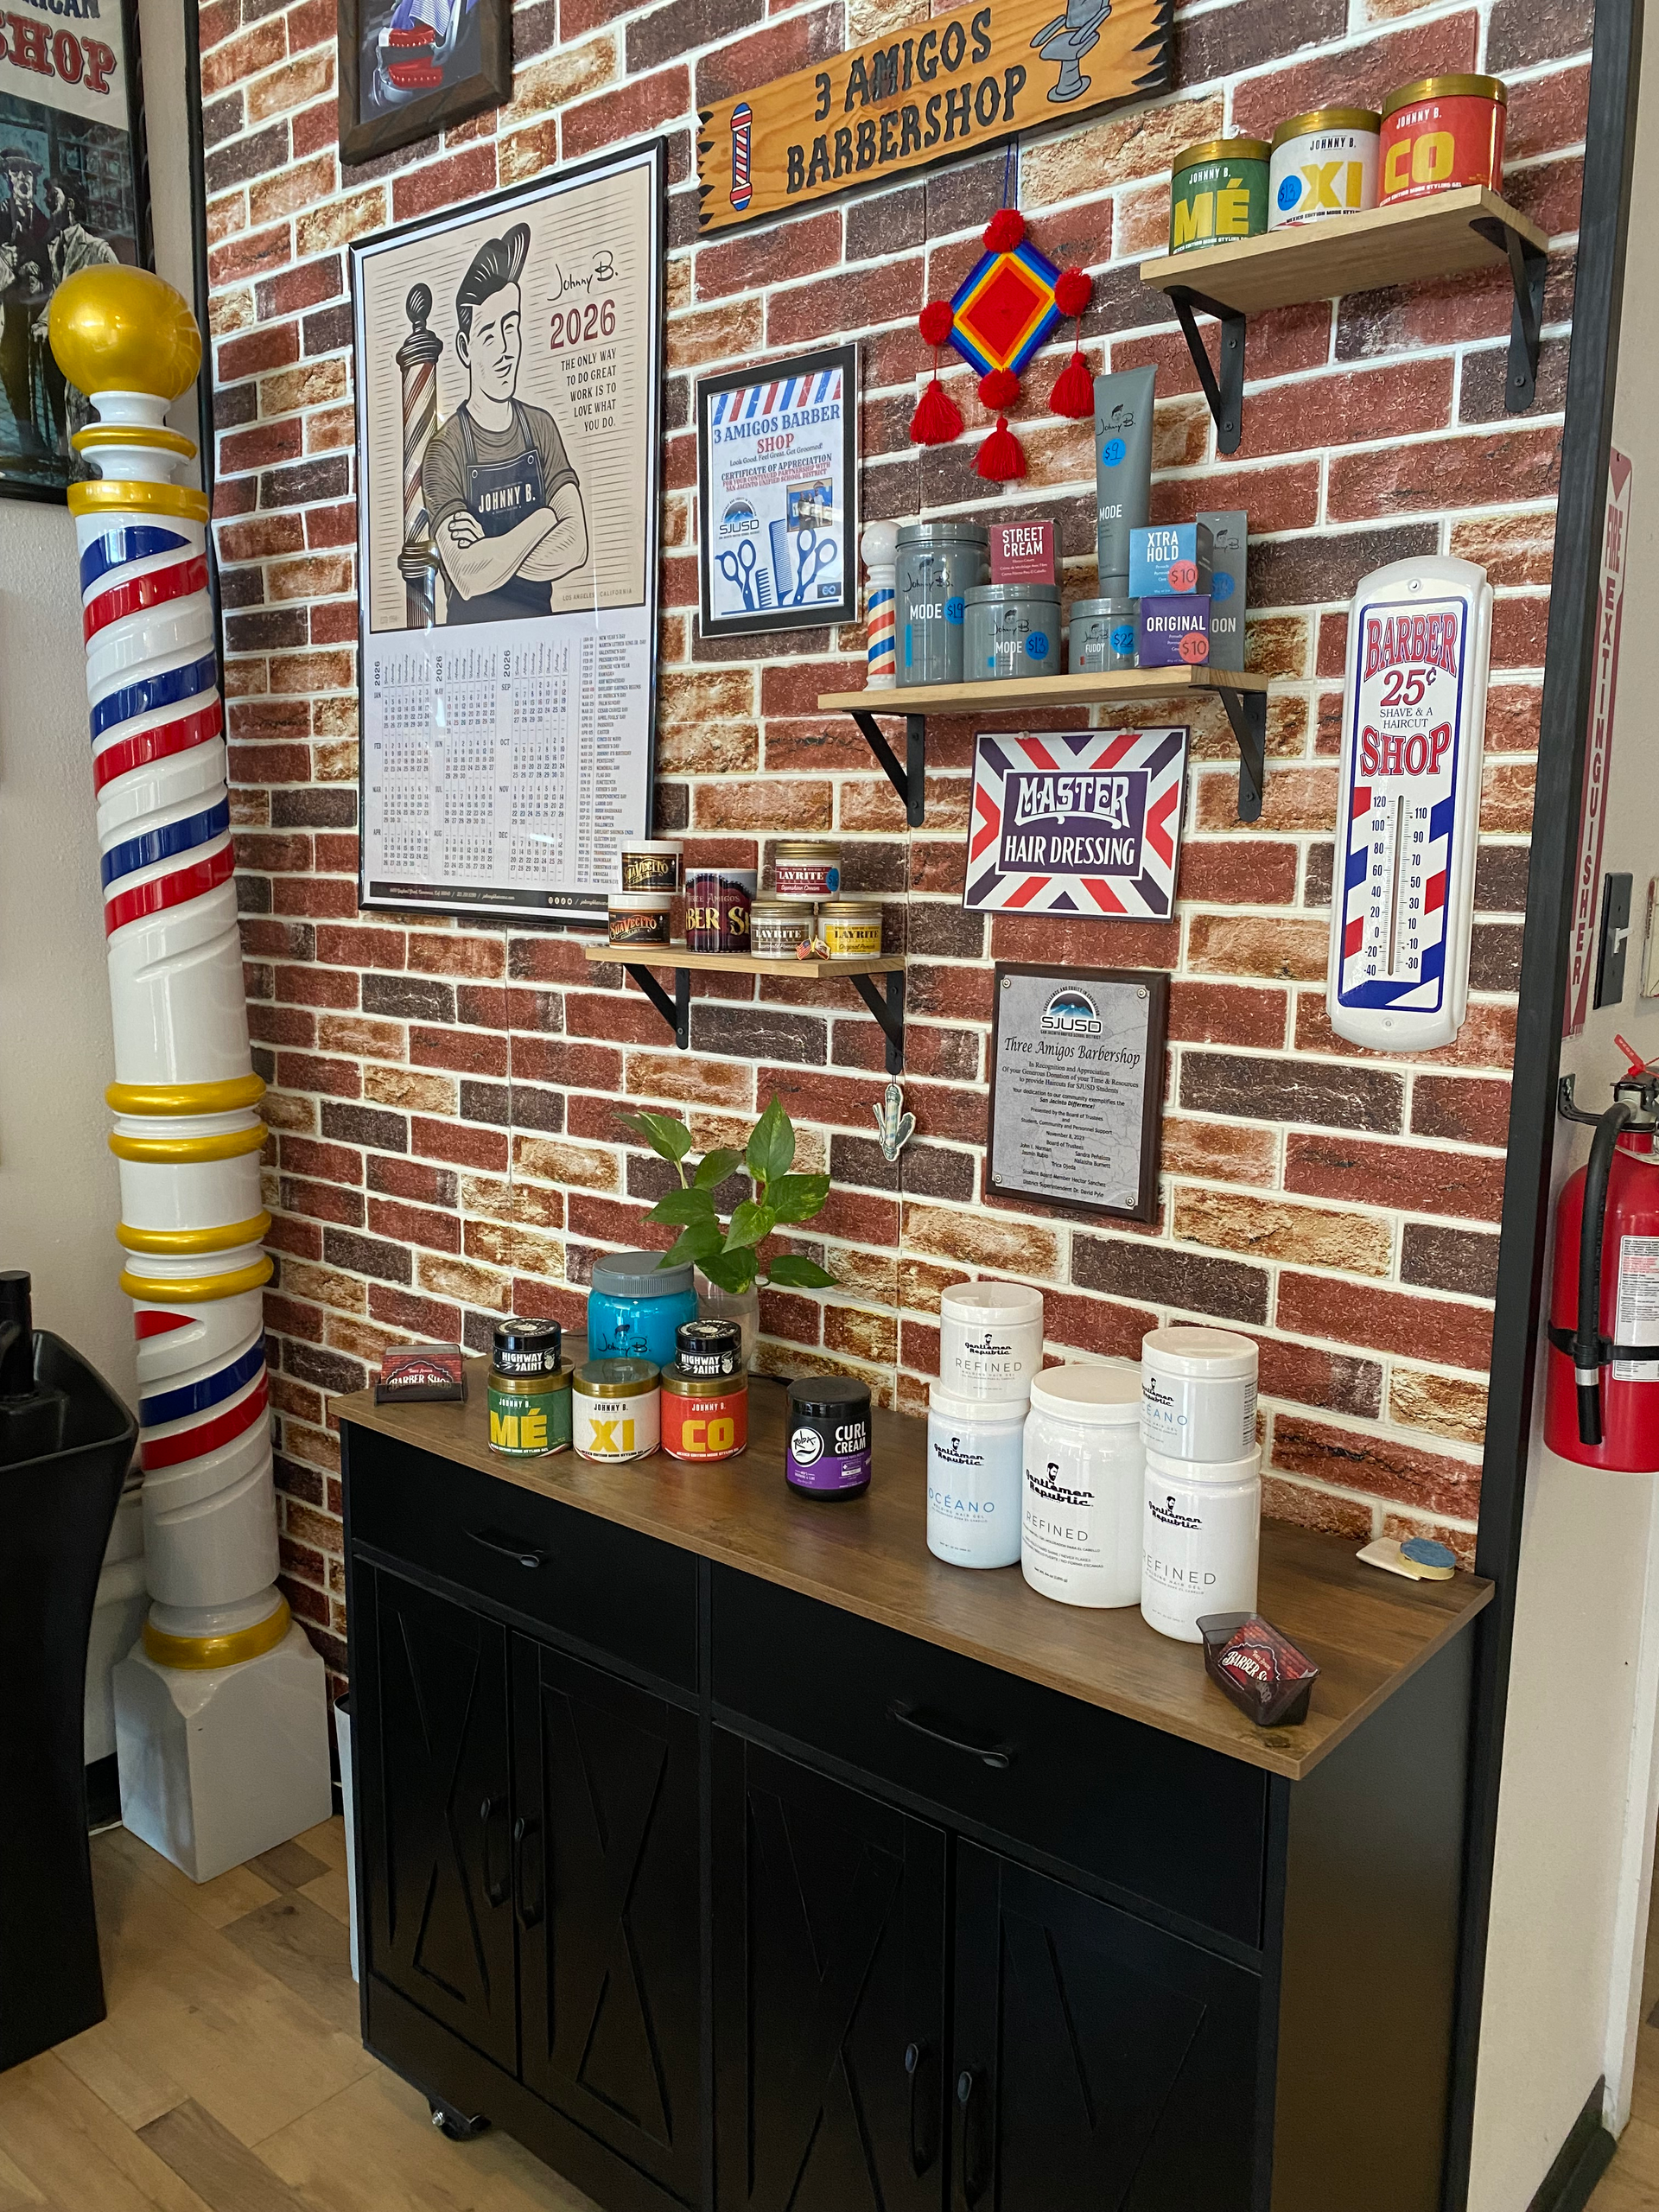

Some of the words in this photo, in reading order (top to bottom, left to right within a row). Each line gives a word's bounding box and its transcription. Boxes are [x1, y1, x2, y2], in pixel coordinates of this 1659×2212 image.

[0, 10, 117, 95] HOP
[815, 73, 830, 122] 3
[844, 7, 991, 113] AMIGOS
[1396, 109, 1429, 129] JOHNNY
[1433, 107, 1442, 118] B.
[786, 65, 1027, 194] BARBERSHOP
[1310, 137, 1344, 150] JOHNNY
[1349, 137, 1357, 149] B.
[1384, 131, 1454, 194] CO
[1189, 168, 1220, 184] JOHNNY
[1224, 167, 1231, 177] B.
[1299, 161, 1363, 213] XI
[1174, 178, 1249, 247] MÉ
[547, 264, 593, 301] Johnny
[593, 251, 618, 281] B.
[550, 299, 615, 350] 2026
[561, 359, 575, 372] THE
[577, 353, 597, 367] ONLY
[600, 347, 617, 361] WAY
[567, 374, 576, 386] TO
[578, 372, 588, 384] DO
[591, 365, 616, 380] GREAT
[570, 387, 593, 402] WORK
[595, 385, 603, 396] IS
[607, 382, 616, 393] TO
[574, 404, 592, 417] LOVE
[594, 399, 616, 415] WHAT
[584, 418, 599, 431] YOU
[602, 416, 616, 429] DO.
[714, 429, 721, 443] 3
[723, 416, 778, 442] AMIGOS
[782, 404, 840, 429] BARBER
[757, 433, 794, 454] SHOP
[1105, 442, 1122, 461] $9
[721, 466, 766, 481] CERTIFICATE
[768, 463, 778, 472] OF
[778, 453, 832, 470] APPRECIATION
[479, 486, 521, 513] JOHNNY
[525, 483, 536, 503] B.
[1099, 504, 1122, 521] MODE
[719, 519, 760, 535] SJUSD
[1002, 526, 1044, 543] STREET
[1147, 531, 1179, 548] XTRA
[1605, 503, 1624, 574] FIRE
[1003, 541, 1043, 557] CREAM
[1147, 545, 1179, 563] HOLD
[1172, 569, 1196, 584] $10
[600, 588, 632, 597] CALIFORNIA
[910, 603, 942, 620] MODE
[1146, 615, 1206, 632] ORIGINAL
[1210, 617, 1236, 633] OON
[995, 641, 1022, 654] MODE
[1085, 643, 1105, 653] FUDDY
[1114, 632, 1134, 647] $22
[1182, 639, 1207, 656] $10
[1363, 613, 1458, 683] BARBER
[1380, 667, 1436, 706] 25¢
[1379, 709, 1413, 717] SHAVE
[1426, 708, 1433, 716] A
[1382, 719, 1428, 729] HAIRCUT
[1360, 721, 1452, 777] SHOP
[1573, 576, 1616, 985] EXTINGUISHER
[1014, 776, 1131, 830] MASTER
[1373, 796, 1386, 808] 120
[1414, 807, 1427, 819] 110
[1371, 820, 1384, 831] 100
[1414, 831, 1424, 843] 90
[1004, 836, 1046, 866] HAIR
[1050, 836, 1135, 868] DRESSING
[1374, 842, 1383, 854] 80
[1412, 854, 1421, 866] 70
[779, 871, 824, 880] LAYRITE
[1372, 864, 1382, 876] 60
[1410, 877, 1421, 888] 50
[1371, 886, 1381, 898] 40
[1370, 906, 1380, 918] 20
[1409, 898, 1420, 910] 30
[1408, 918, 1417, 930] 10
[755, 930, 801, 938] LAYRITE
[835, 930, 879, 938] LAYRITE
[1364, 946, 1377, 957] -20
[1363, 965, 1376, 976] -40
[1405, 957, 1419, 969] -30
[1041, 1016, 1102, 1033] SJUSD
[1004, 1036, 1033, 1053] Three
[1035, 1040, 1075, 1061] Amigos
[1077, 1045, 1141, 1069] Barbershop
[1035, 1062, 1065, 1072] Recognition
[1077, 1068, 1110, 1077] Appreciation
[1096, 1085, 1119, 1094] Students
[598, 1333, 629, 1357] Johnny
[964, 1342, 1012, 1351] Gentleman
[502, 1351, 543, 1362] HIGHWAY
[681, 1353, 720, 1365] HIGHWAY
[955, 1357, 1022, 1372] REFINED
[515, 1360, 543, 1371] SAINT
[693, 1363, 721, 1374] SAINT
[499, 1398, 523, 1408] JOHNNY
[691, 1402, 718, 1411] JOHNNY
[490, 1408, 547, 1448] MÉ
[588, 1419, 635, 1452] XI
[682, 1417, 734, 1452] CO
[835, 1421, 866, 1442] CURL
[835, 1437, 867, 1454] CREAM
[934, 1443, 984, 1460] Gentleman
[1027, 1469, 1095, 1498] Gentleman
[928, 1487, 995, 1512] OCÉANO
[1148, 1500, 1202, 1524] Gentleman
[1027, 1510, 1088, 1541] REFINED
[1142, 1550, 1217, 1586] REFINED
[1222, 1651, 1260, 1676] BARBER
